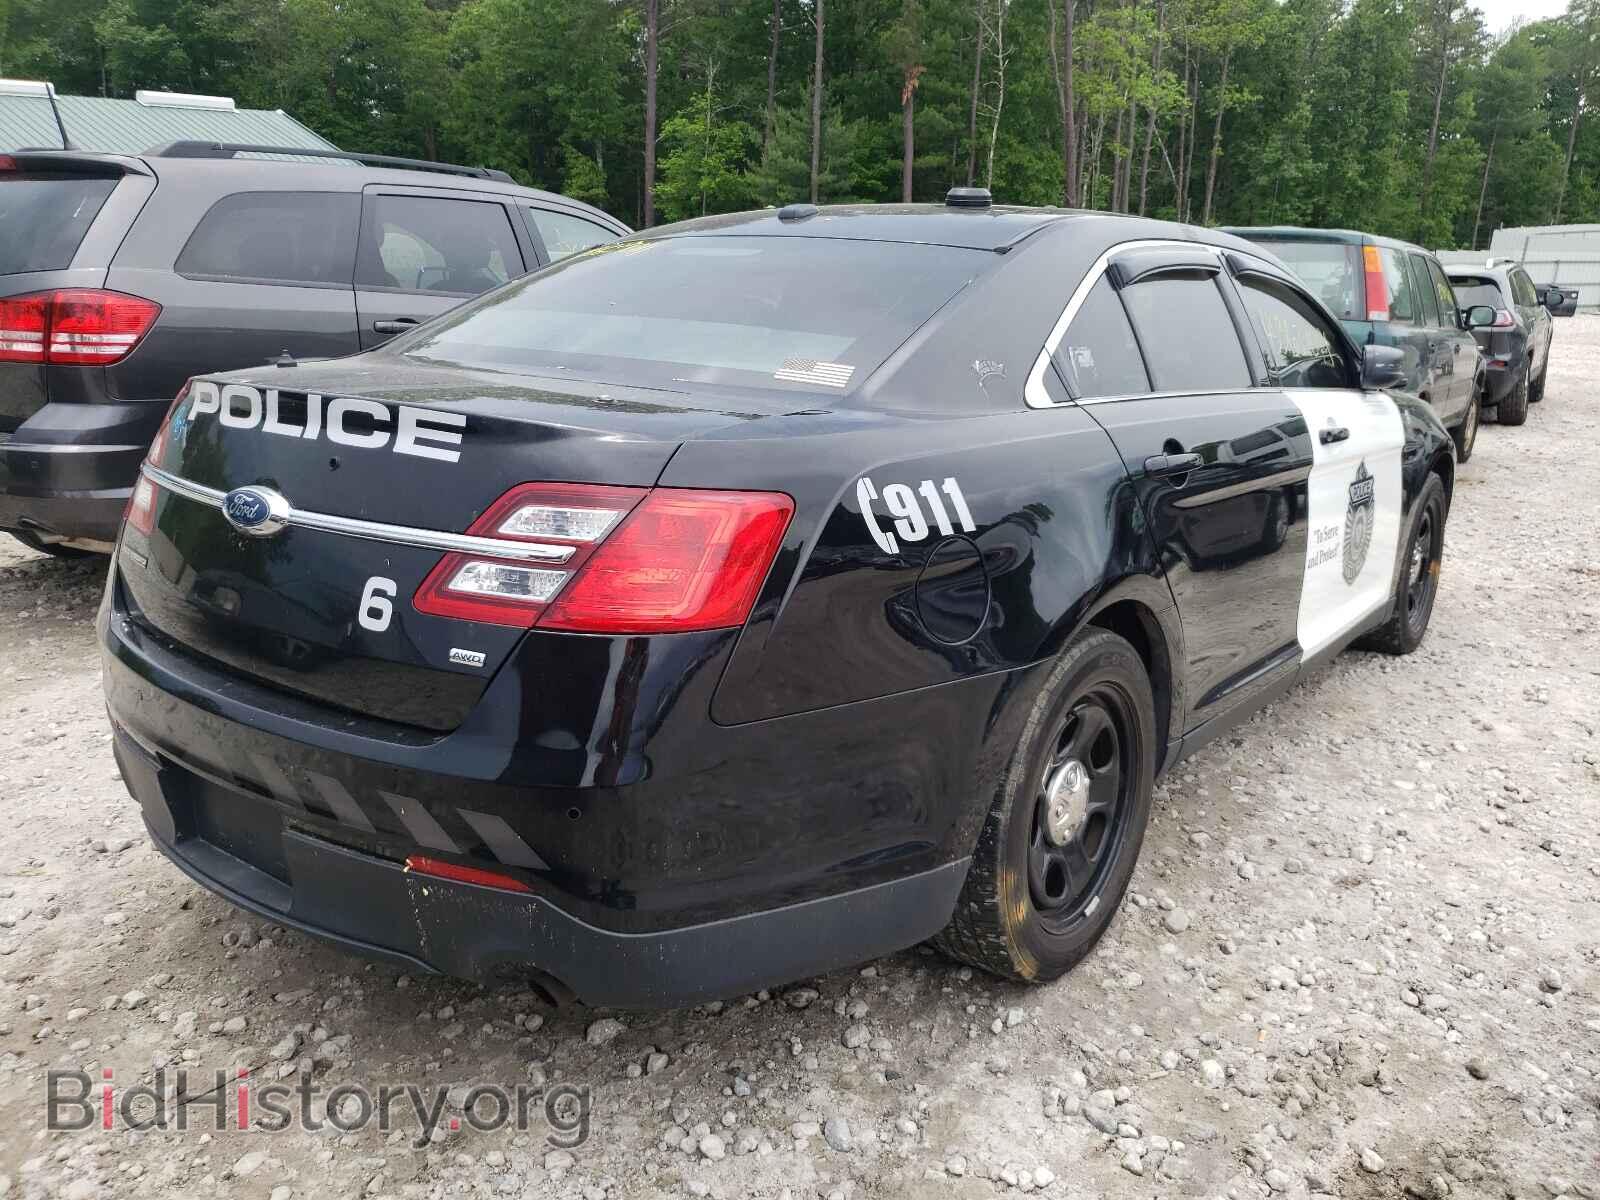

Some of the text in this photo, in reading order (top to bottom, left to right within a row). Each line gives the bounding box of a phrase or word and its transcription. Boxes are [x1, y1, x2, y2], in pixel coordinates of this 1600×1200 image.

[187, 381, 467, 463] POLICE
[230, 493, 260, 518] Ford
[882, 477, 976, 541] 911
[359, 576, 397, 632] 6
[452, 652, 481, 663] AWD
